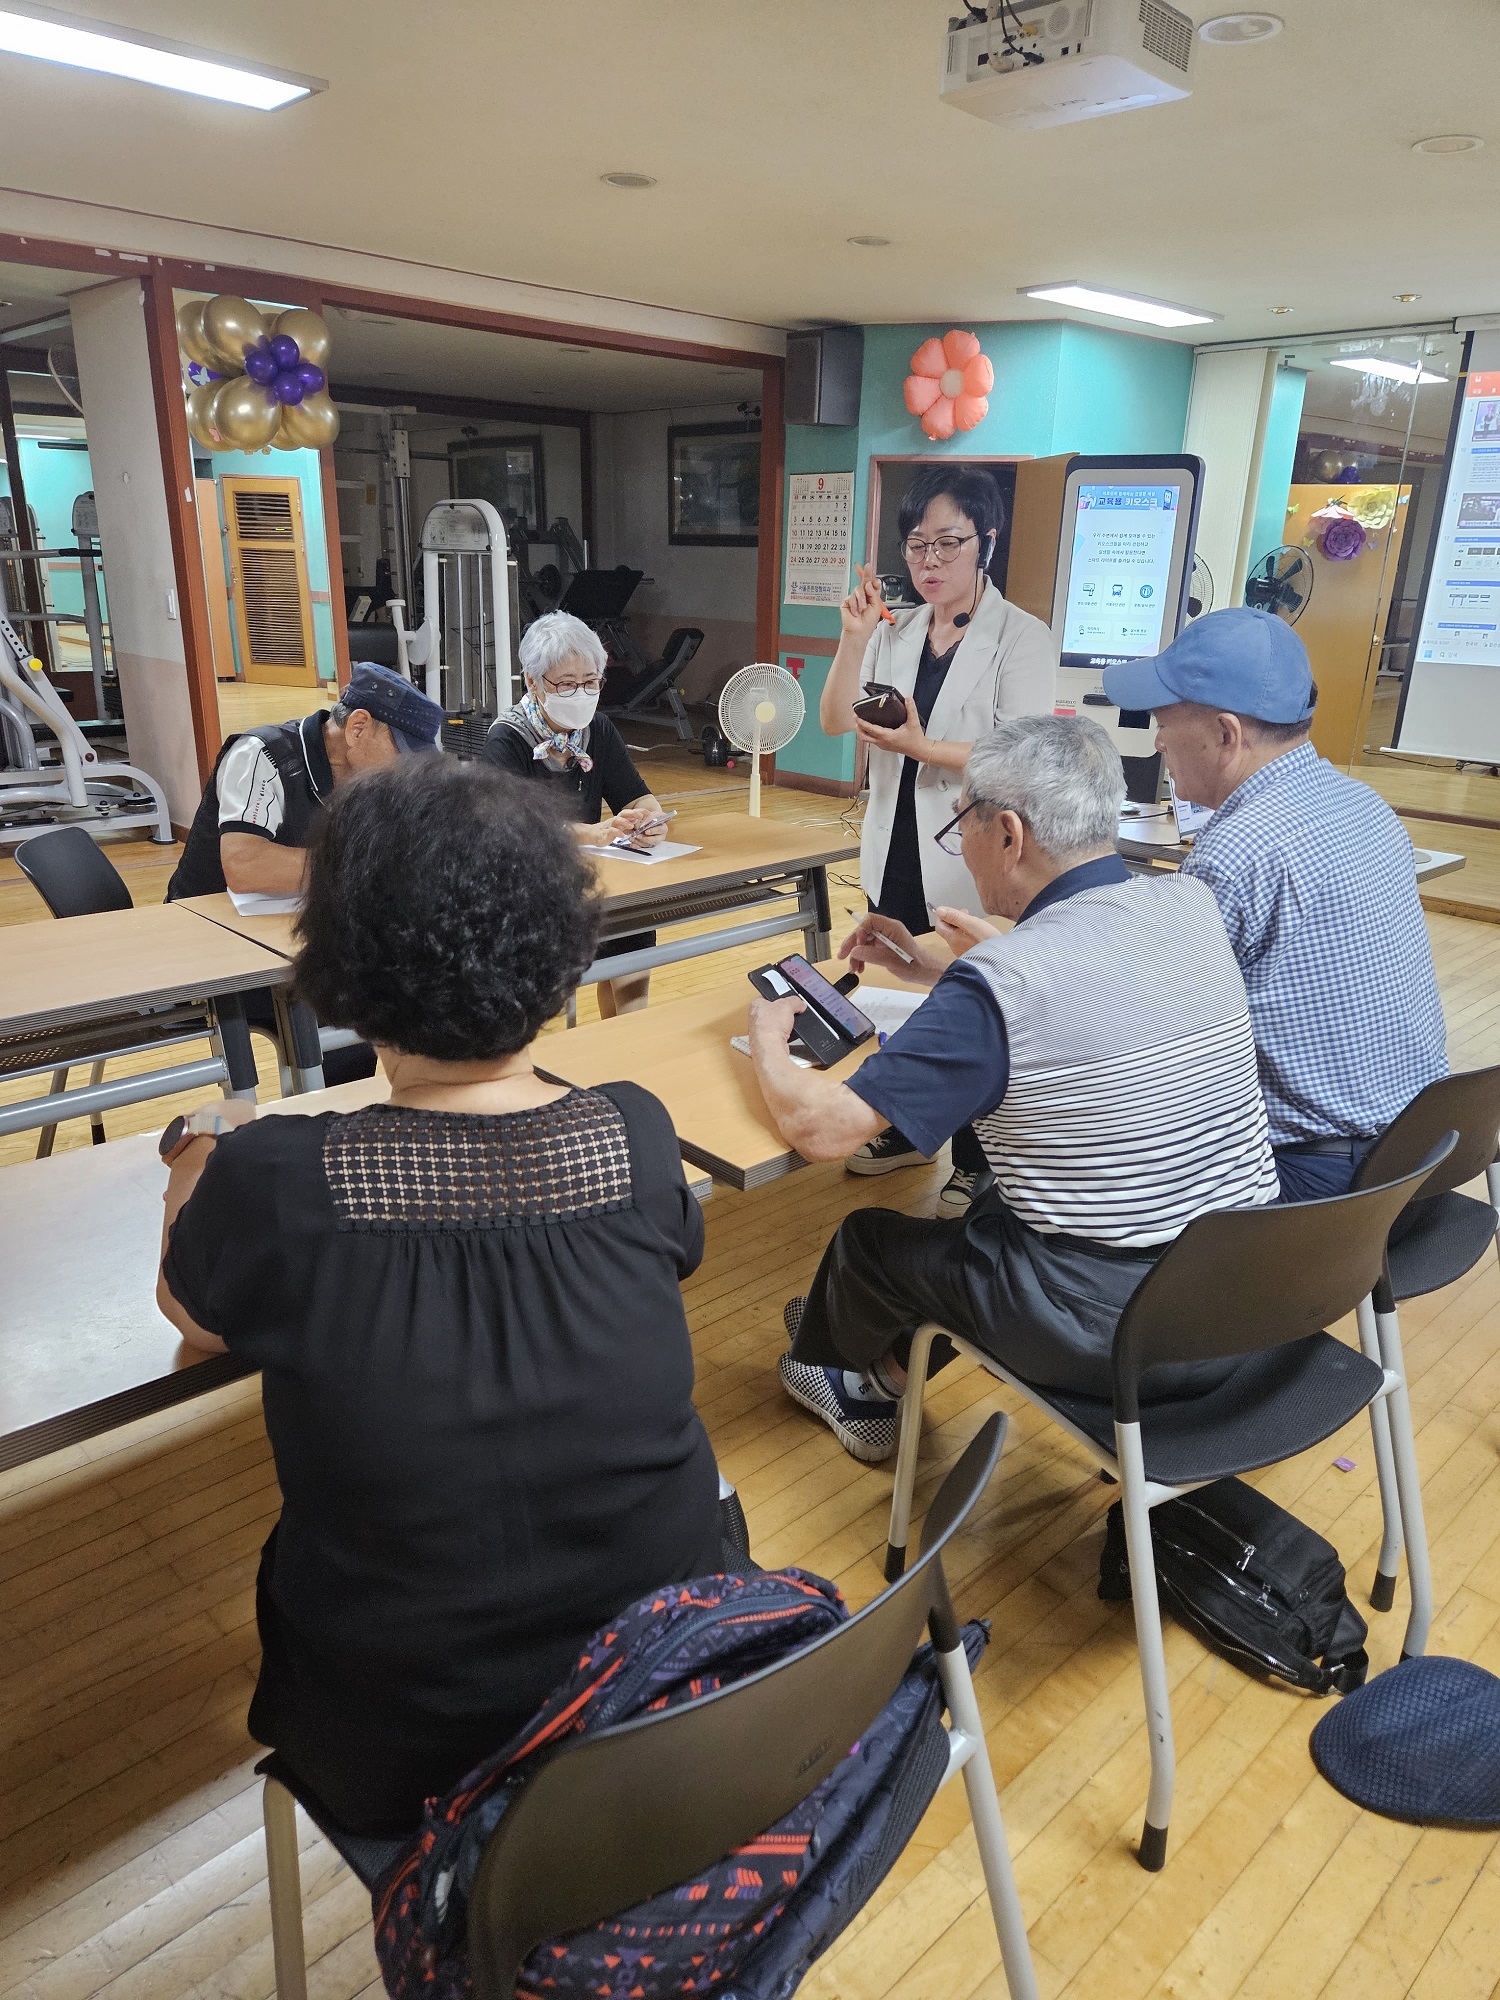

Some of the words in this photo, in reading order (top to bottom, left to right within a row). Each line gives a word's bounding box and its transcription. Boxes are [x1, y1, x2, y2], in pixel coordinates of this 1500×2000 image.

[818, 478, 824, 490] 9
[1098, 497, 1122, 506] 교육용
[1125, 497, 1158, 506] 키오스크
